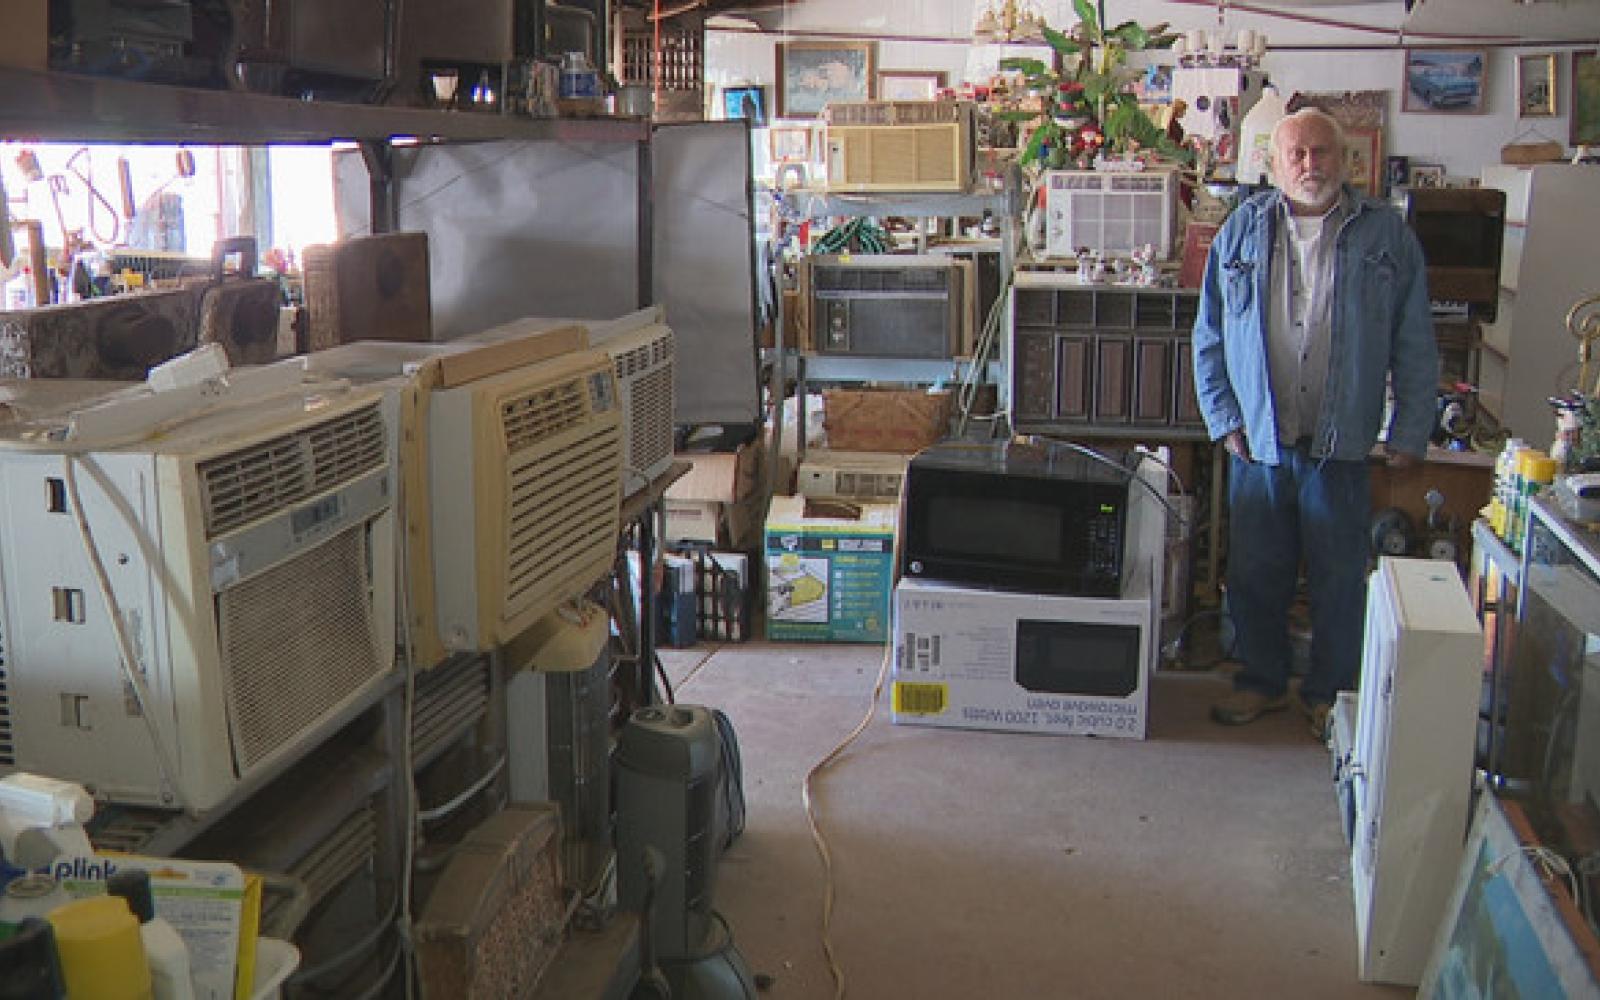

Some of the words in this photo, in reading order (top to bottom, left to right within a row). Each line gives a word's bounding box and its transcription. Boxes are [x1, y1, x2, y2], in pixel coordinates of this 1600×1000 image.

[1026, 696, 1060, 710] oven
[1062, 700, 1137, 715] microwave
[1005, 711, 1037, 724] 1200
[1077, 715, 1112, 729] cubic
